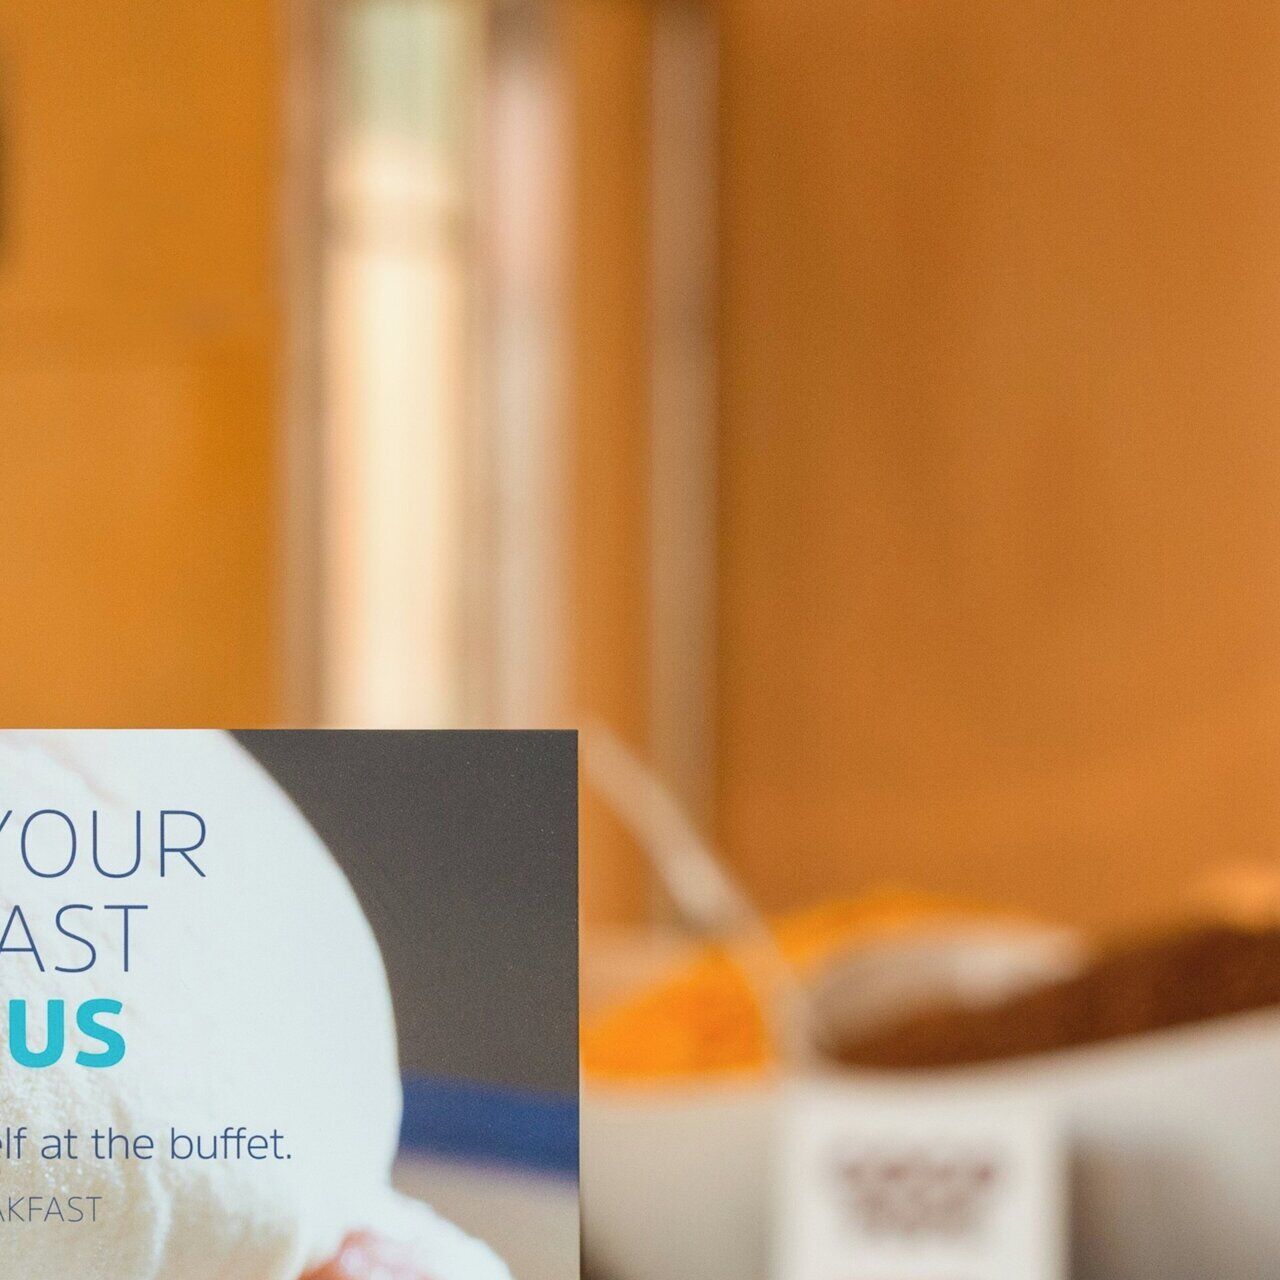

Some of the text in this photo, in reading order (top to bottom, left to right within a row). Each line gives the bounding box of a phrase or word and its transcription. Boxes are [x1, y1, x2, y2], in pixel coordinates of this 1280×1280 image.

[8, 997, 127, 1070] US
[40, 1128, 79, 1160] at
[90, 1127, 154, 1160] the
[170, 1126, 293, 1160] buffet.
